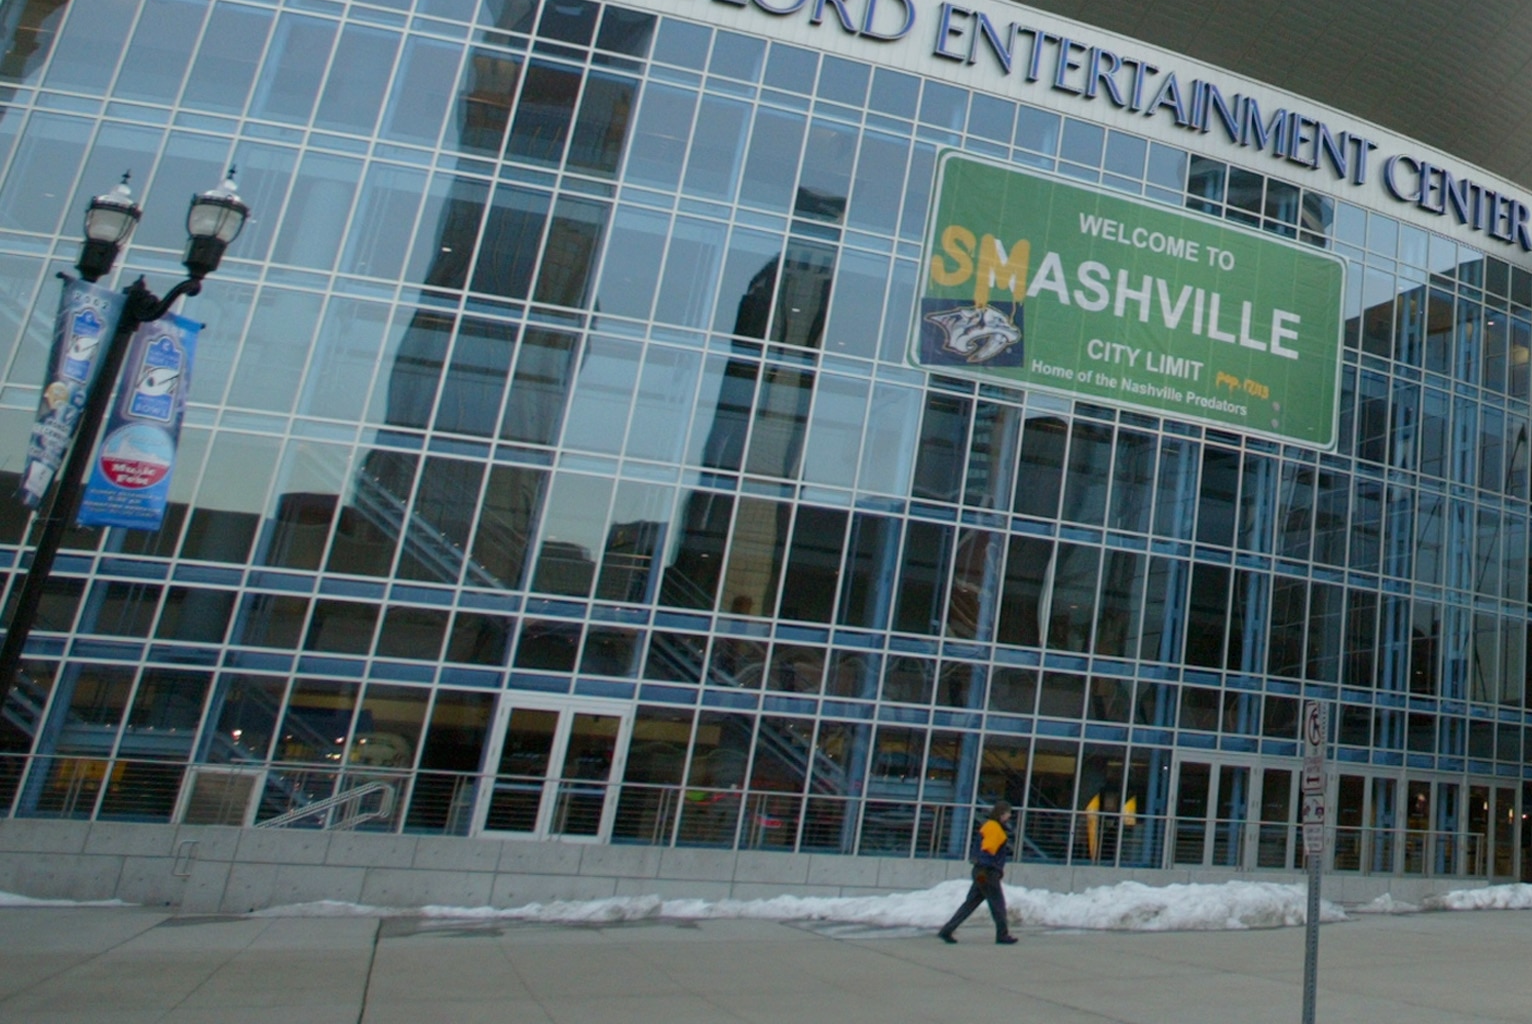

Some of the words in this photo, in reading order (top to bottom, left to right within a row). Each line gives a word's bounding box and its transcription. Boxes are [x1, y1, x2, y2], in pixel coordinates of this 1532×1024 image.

[932, 0, 1379, 186] ENTERTAINMENT
[1079, 212, 1199, 263] WELCOME
[1206, 246, 1236, 272] TO
[1031, 358, 1074, 383] Home
[1077, 370, 1093, 385] of
[1095, 373, 1118, 390] the
[1120, 376, 1183, 404] Nashville
[1185, 390, 1248, 417] Predators
[1087, 338, 1141, 370] CITY
[1145, 347, 1205, 382] LIMIT
